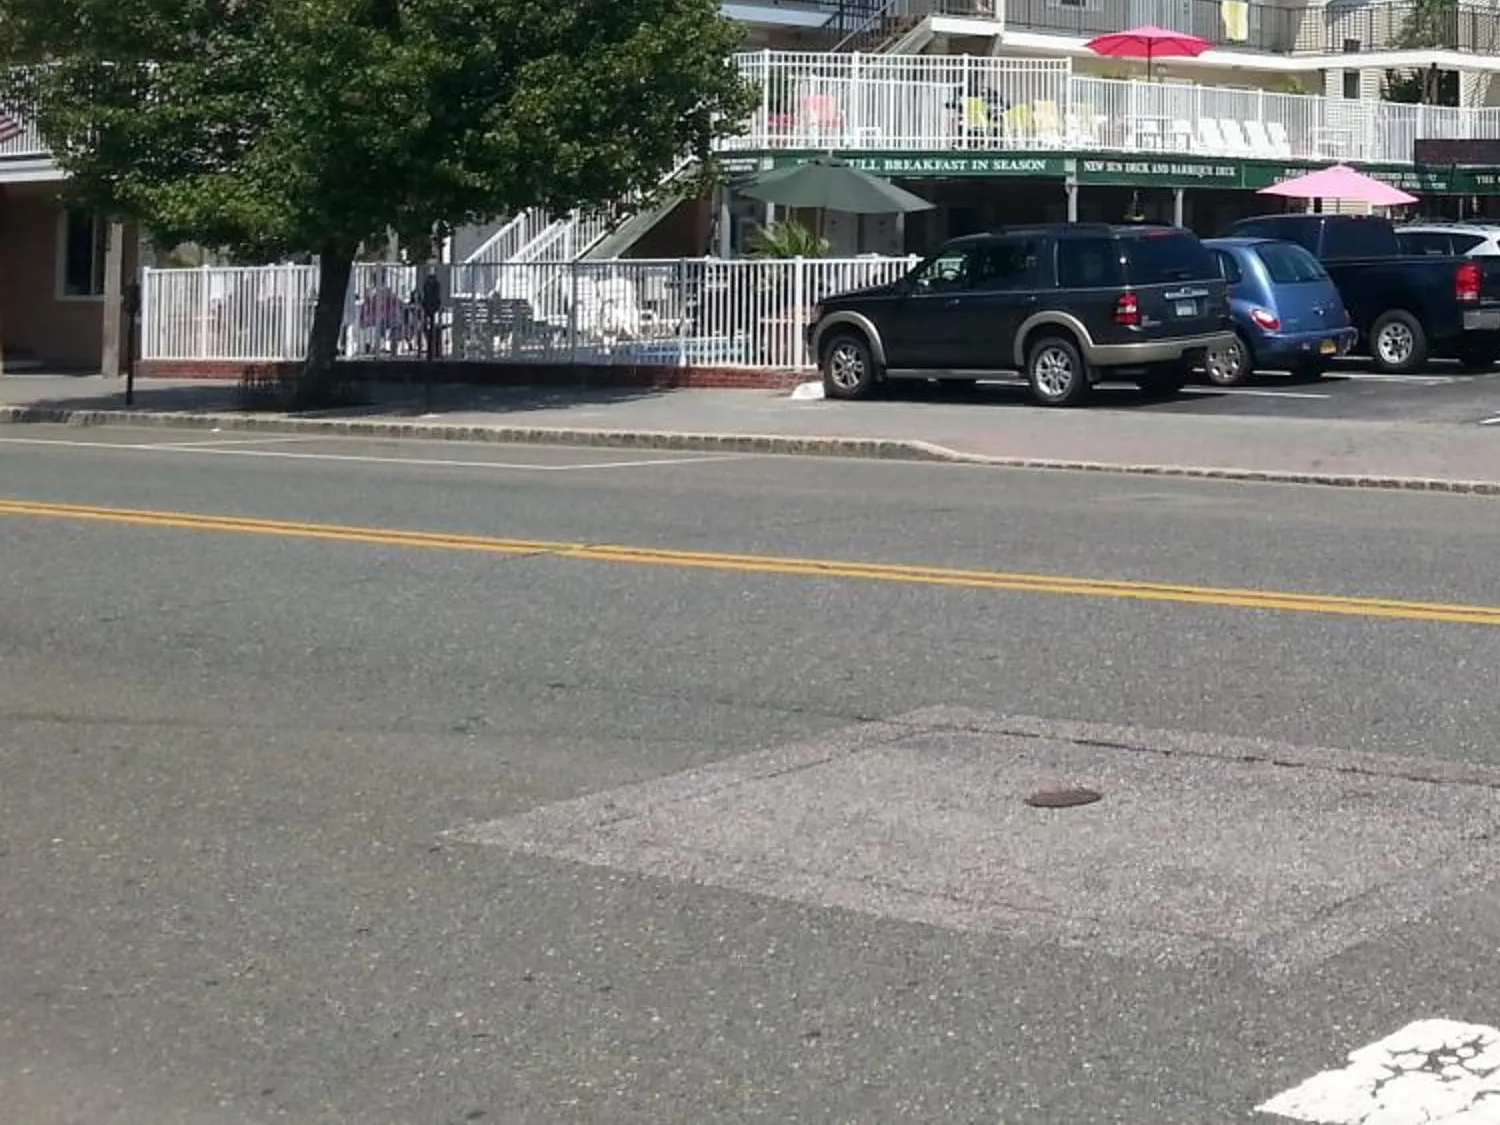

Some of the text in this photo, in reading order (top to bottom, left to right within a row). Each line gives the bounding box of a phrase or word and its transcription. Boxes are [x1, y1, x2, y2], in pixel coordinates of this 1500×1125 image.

[884, 158, 967, 171] BREAKFAST
[971, 158, 988, 171] IN
[993, 158, 1047, 171] SEASON
[1083, 160, 1104, 172] NEW
[1151, 162, 1169, 174] AND
